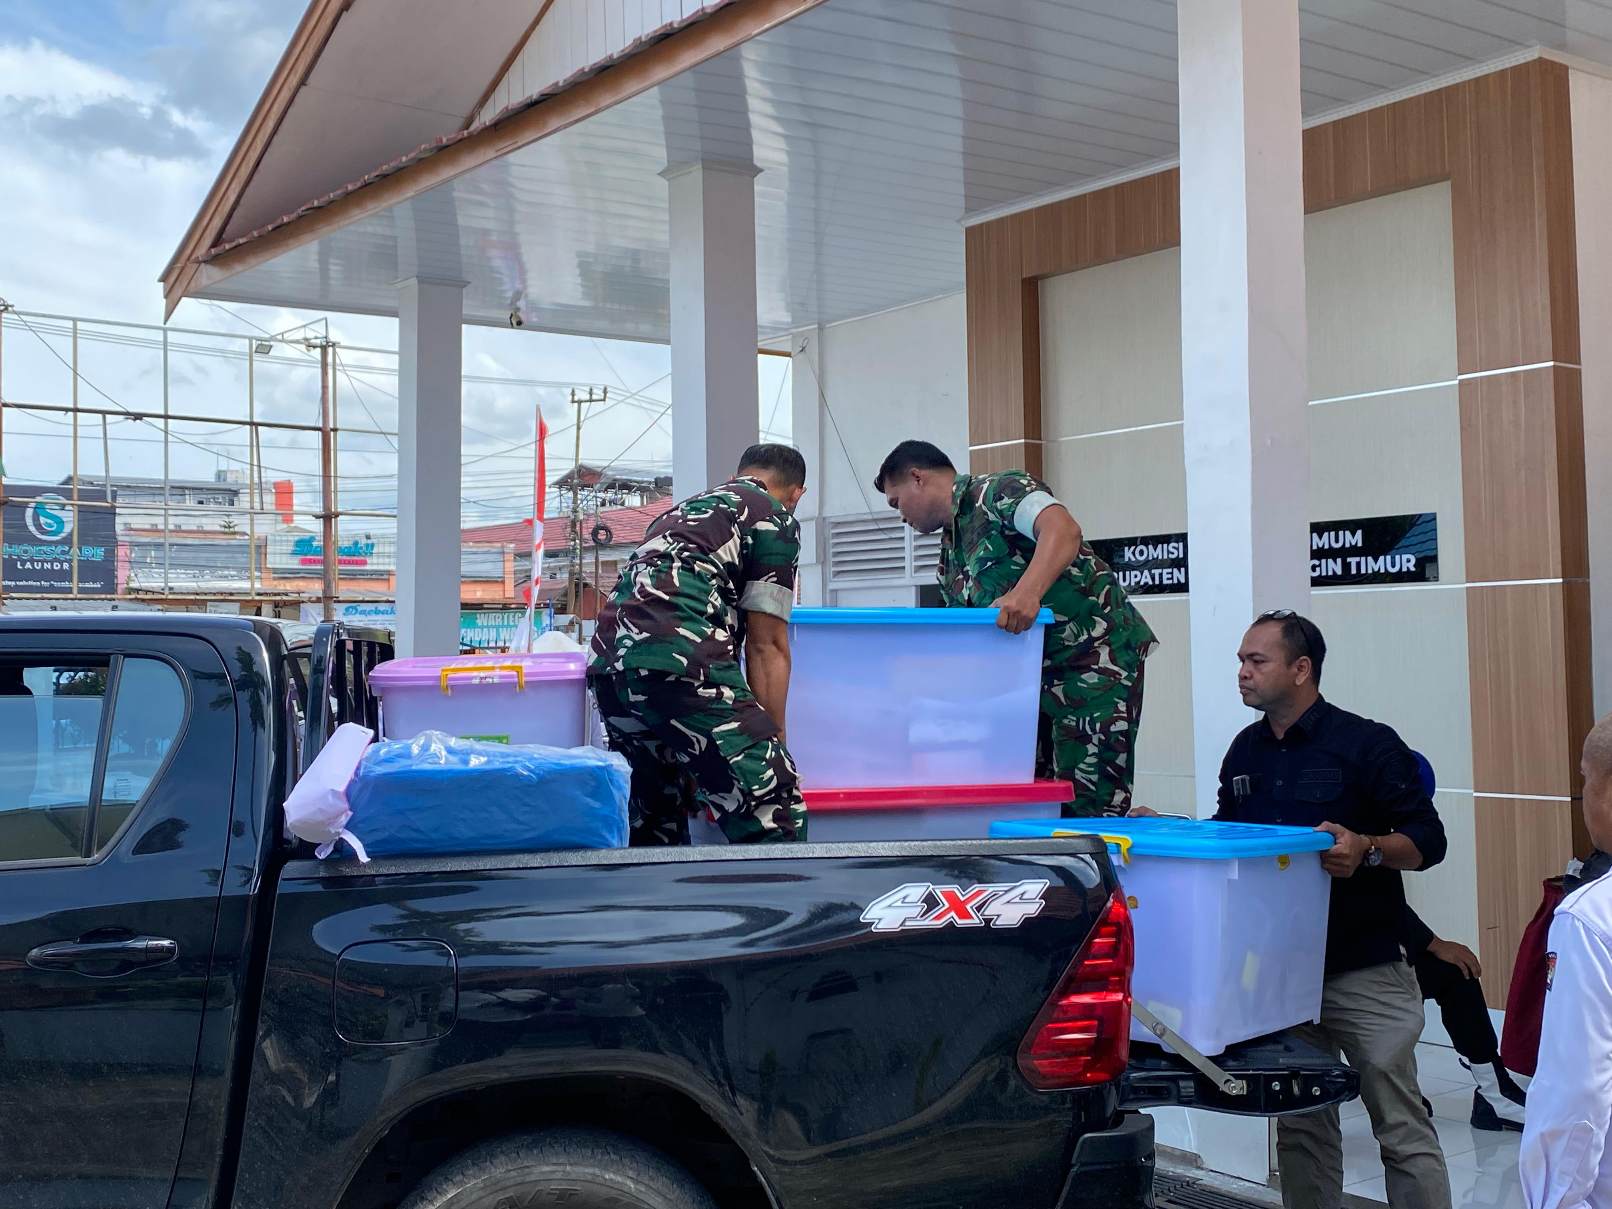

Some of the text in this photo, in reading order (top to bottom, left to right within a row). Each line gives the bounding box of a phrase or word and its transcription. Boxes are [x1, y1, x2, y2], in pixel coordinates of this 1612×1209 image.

[1124, 541, 1184, 562] KOMISI
[17, 561, 73, 570] LAUNDR
[1113, 567, 1186, 586] UPATEN
[1346, 553, 1416, 575] TIMUR
